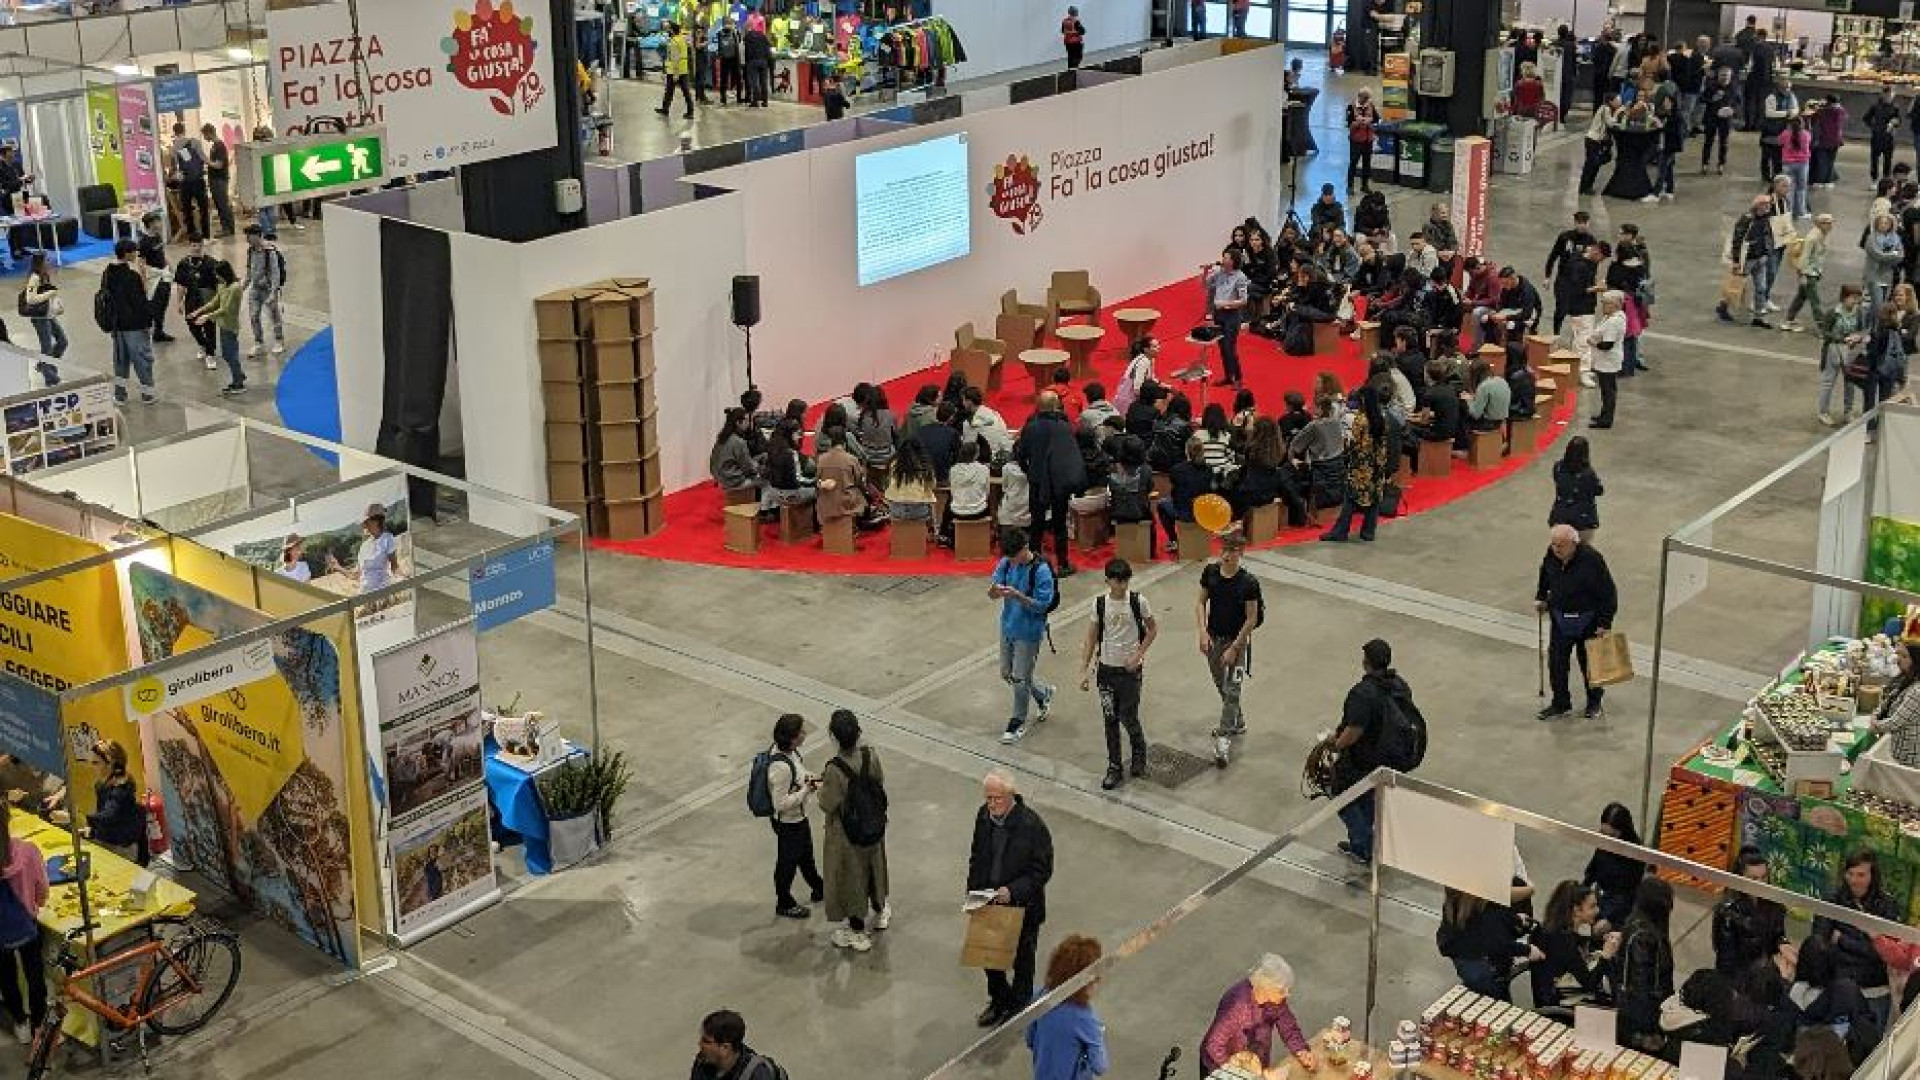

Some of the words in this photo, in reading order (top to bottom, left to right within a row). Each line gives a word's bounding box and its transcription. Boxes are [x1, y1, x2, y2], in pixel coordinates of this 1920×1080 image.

[280, 34, 384, 73] PIAZZA
[483, 41, 513, 60] COSA
[283, 76, 326, 109] Fa'
[335, 73, 362, 101] la
[370, 67, 432, 96] cosa
[1050, 147, 1102, 172] Piazza
[1050, 169, 1080, 200] Fa'
[1085, 166, 1102, 192] la
[1107, 158, 1149, 185] cosa
[1153, 133, 1215, 178] giusta!
[474, 590, 525, 615] Mannos
[168, 663, 234, 696] girolibero
[398, 667, 460, 705] MANNOS
[200, 703, 281, 754] girolibero.it
